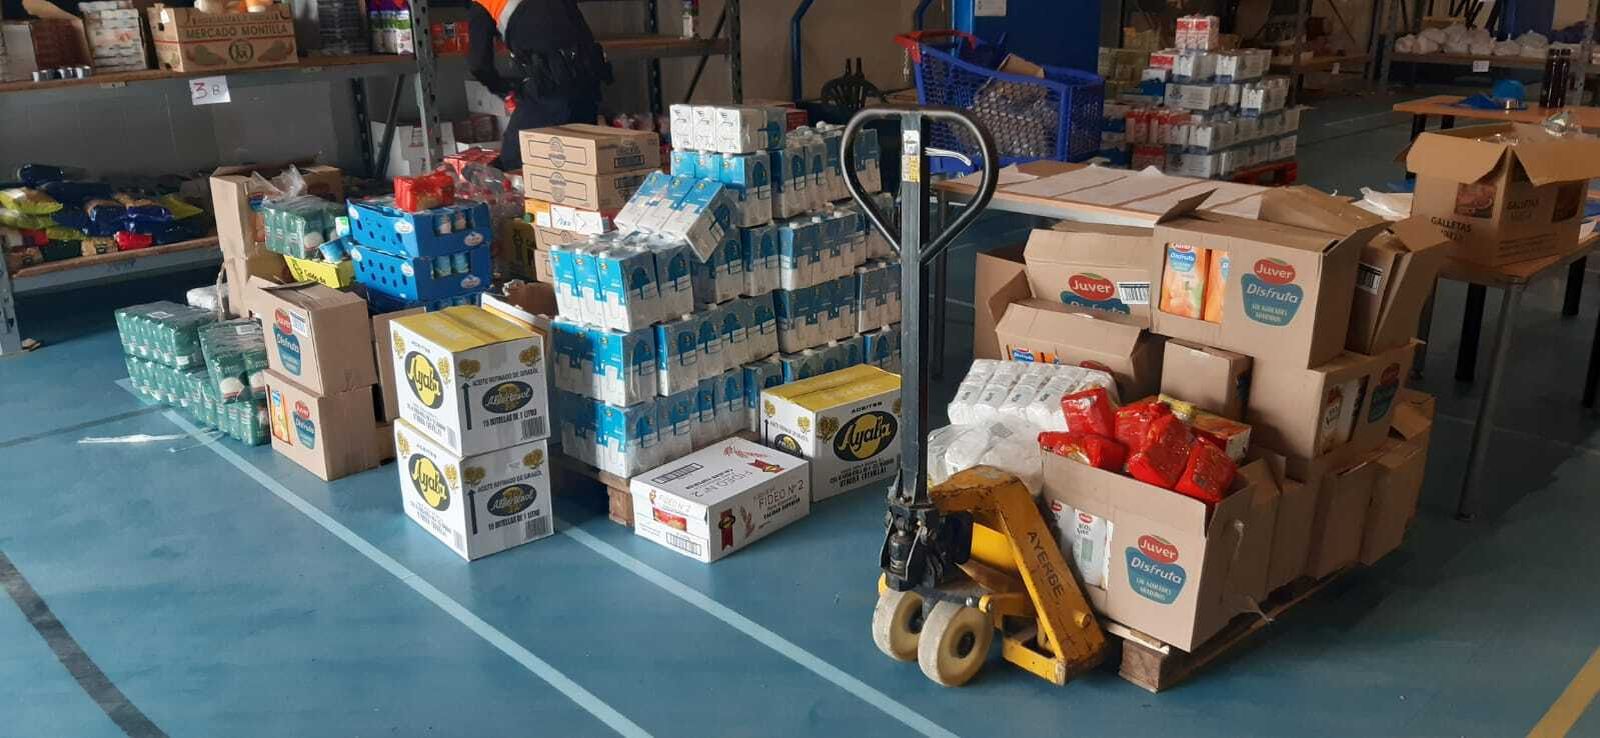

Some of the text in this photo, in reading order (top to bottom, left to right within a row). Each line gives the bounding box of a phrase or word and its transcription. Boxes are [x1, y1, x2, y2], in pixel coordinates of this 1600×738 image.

[185, 23, 288, 39] MERCADO MONTILLA
[193, 81, 208, 100] 3
[1431, 216, 1472, 233] GALLETAS
[1256, 263, 1293, 280] Juver
[1071, 279, 1111, 294] Juver
[1246, 283, 1299, 304] Disfruta
[276, 333, 300, 353] Disfruta
[851, 401, 882, 413] ACEITES
[490, 413, 513, 425] BOTELLAS
[523, 408, 537, 417] LITRO
[758, 488, 785, 508] FIDEO
[797, 479, 804, 490] 2
[495, 514, 517, 528] BOTELLAS
[1140, 539, 1177, 560] Juver
[1026, 531, 1065, 600] AYERBE
[1131, 556, 1182, 585] Disfruta
